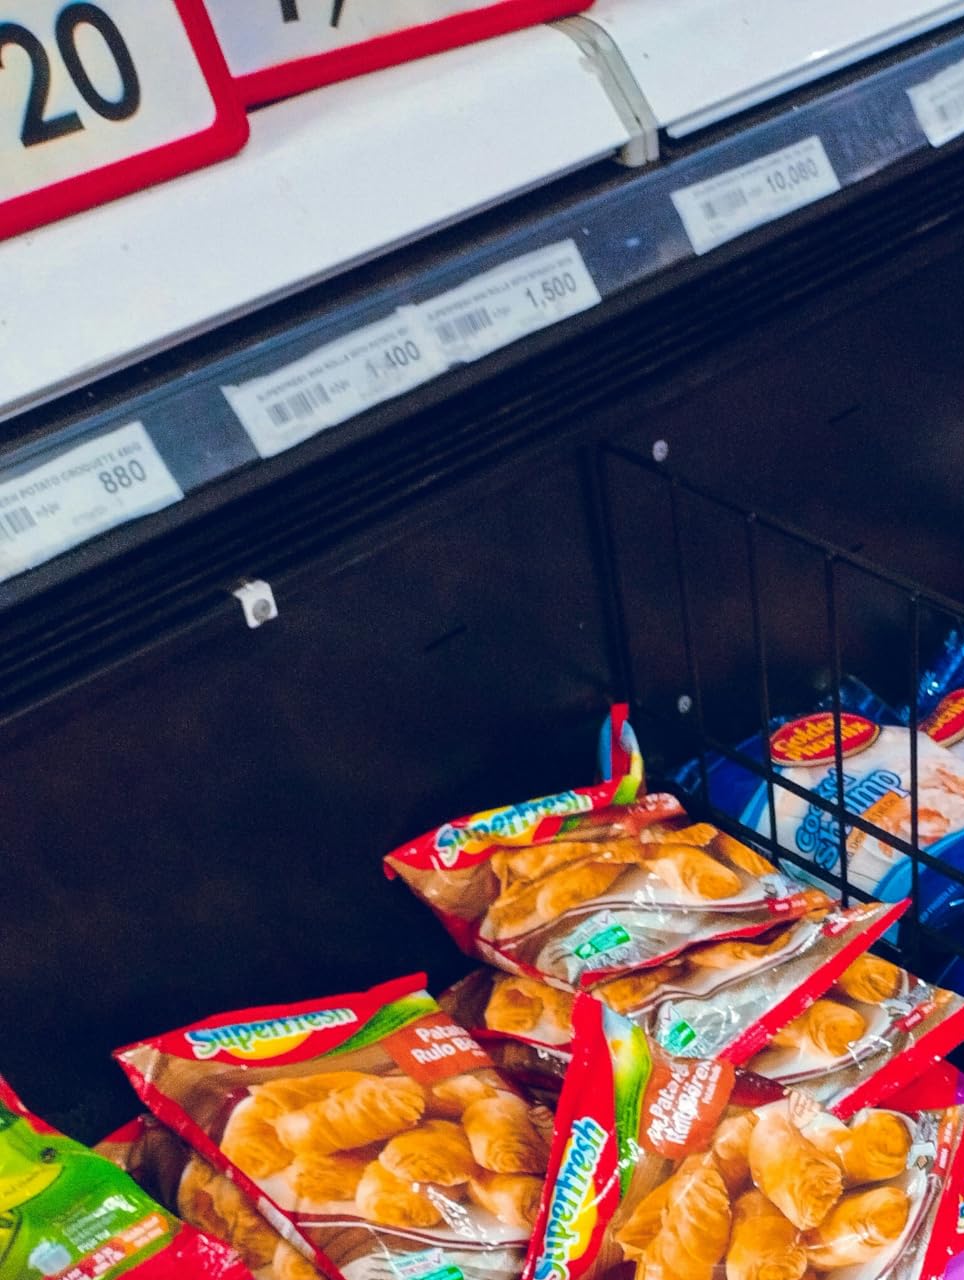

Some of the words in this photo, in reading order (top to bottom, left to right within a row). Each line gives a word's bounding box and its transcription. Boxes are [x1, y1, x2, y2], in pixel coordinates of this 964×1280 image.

[0, 2, 141, 147] 20
[524, 272, 577, 309] 1,500
[366, 340, 421, 379] 1,400
[99, 459, 147, 494] 880
[410, 1043, 455, 1065] Rulo
